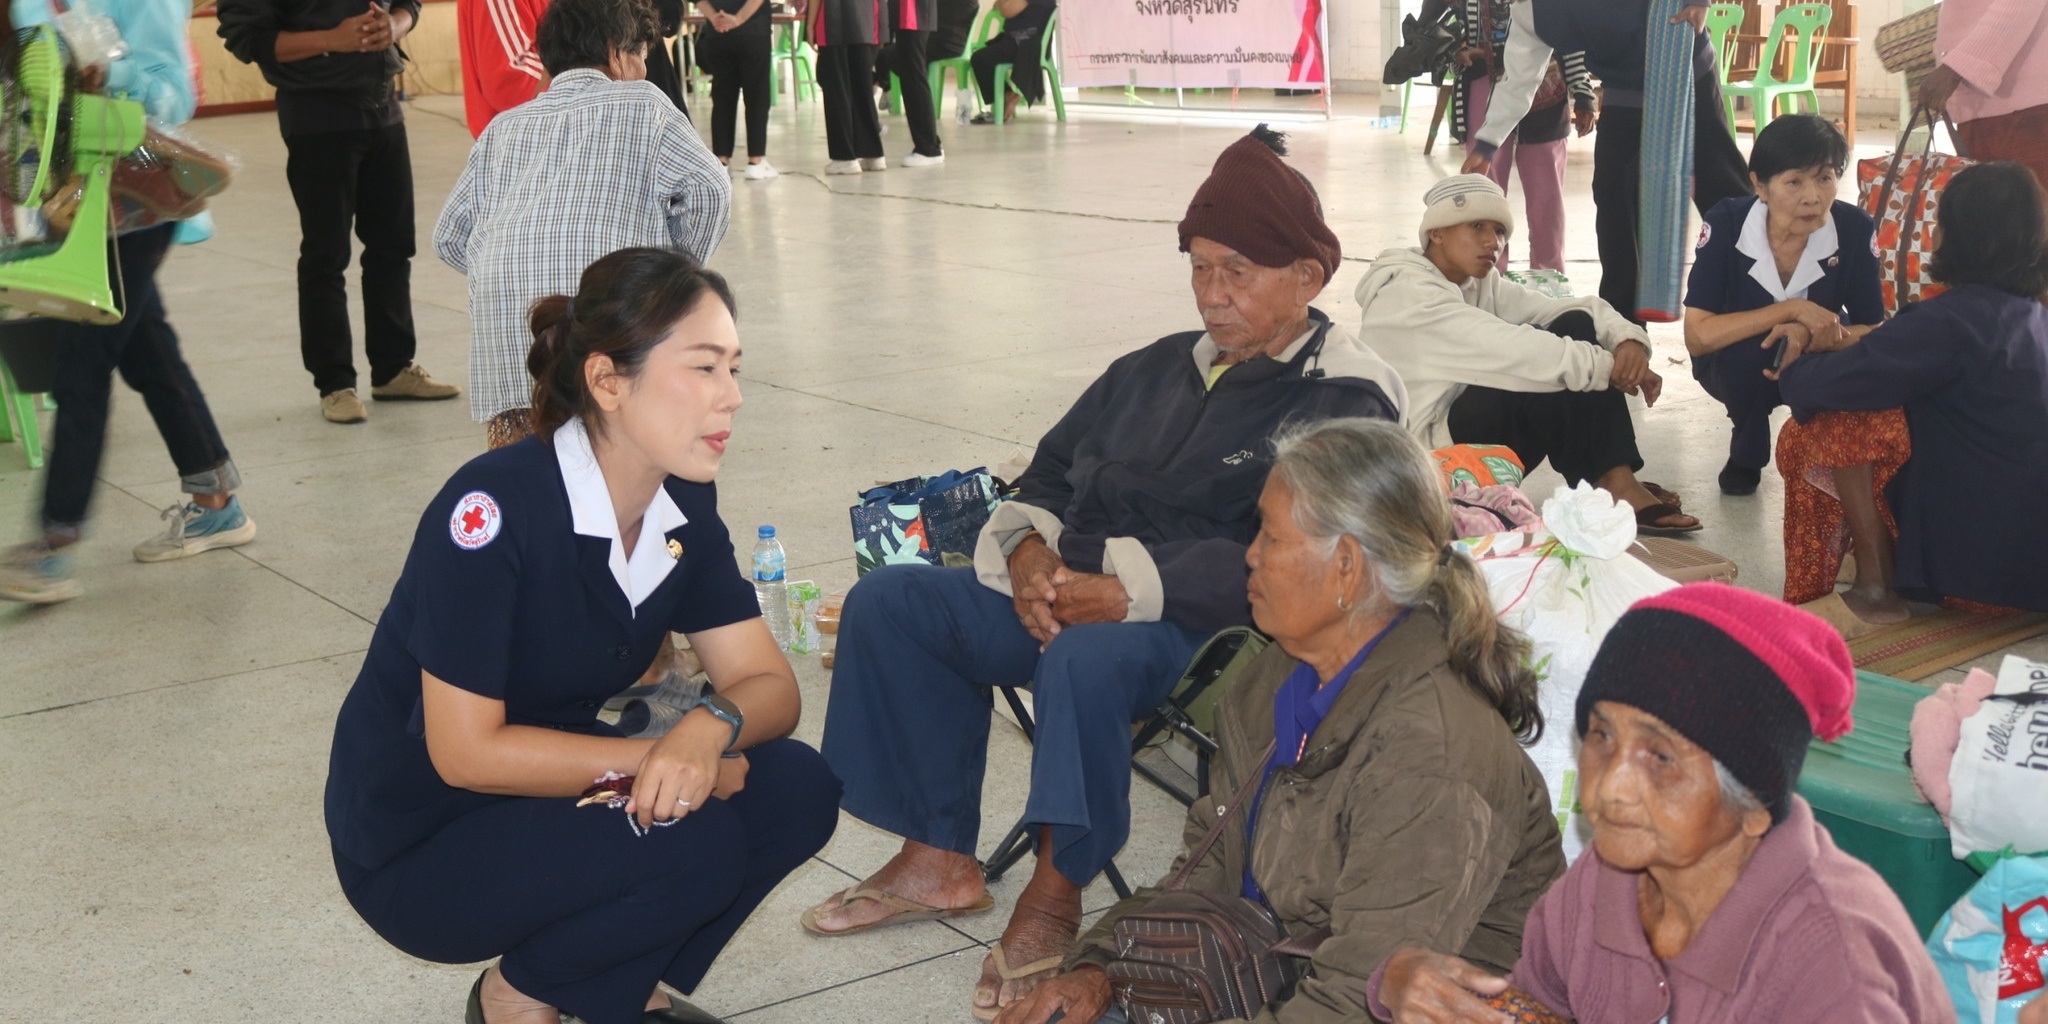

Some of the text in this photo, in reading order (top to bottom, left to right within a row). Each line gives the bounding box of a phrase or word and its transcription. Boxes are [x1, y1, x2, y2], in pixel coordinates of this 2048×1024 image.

[1135, 0, 1240, 24] จงหวดสุรนทร
